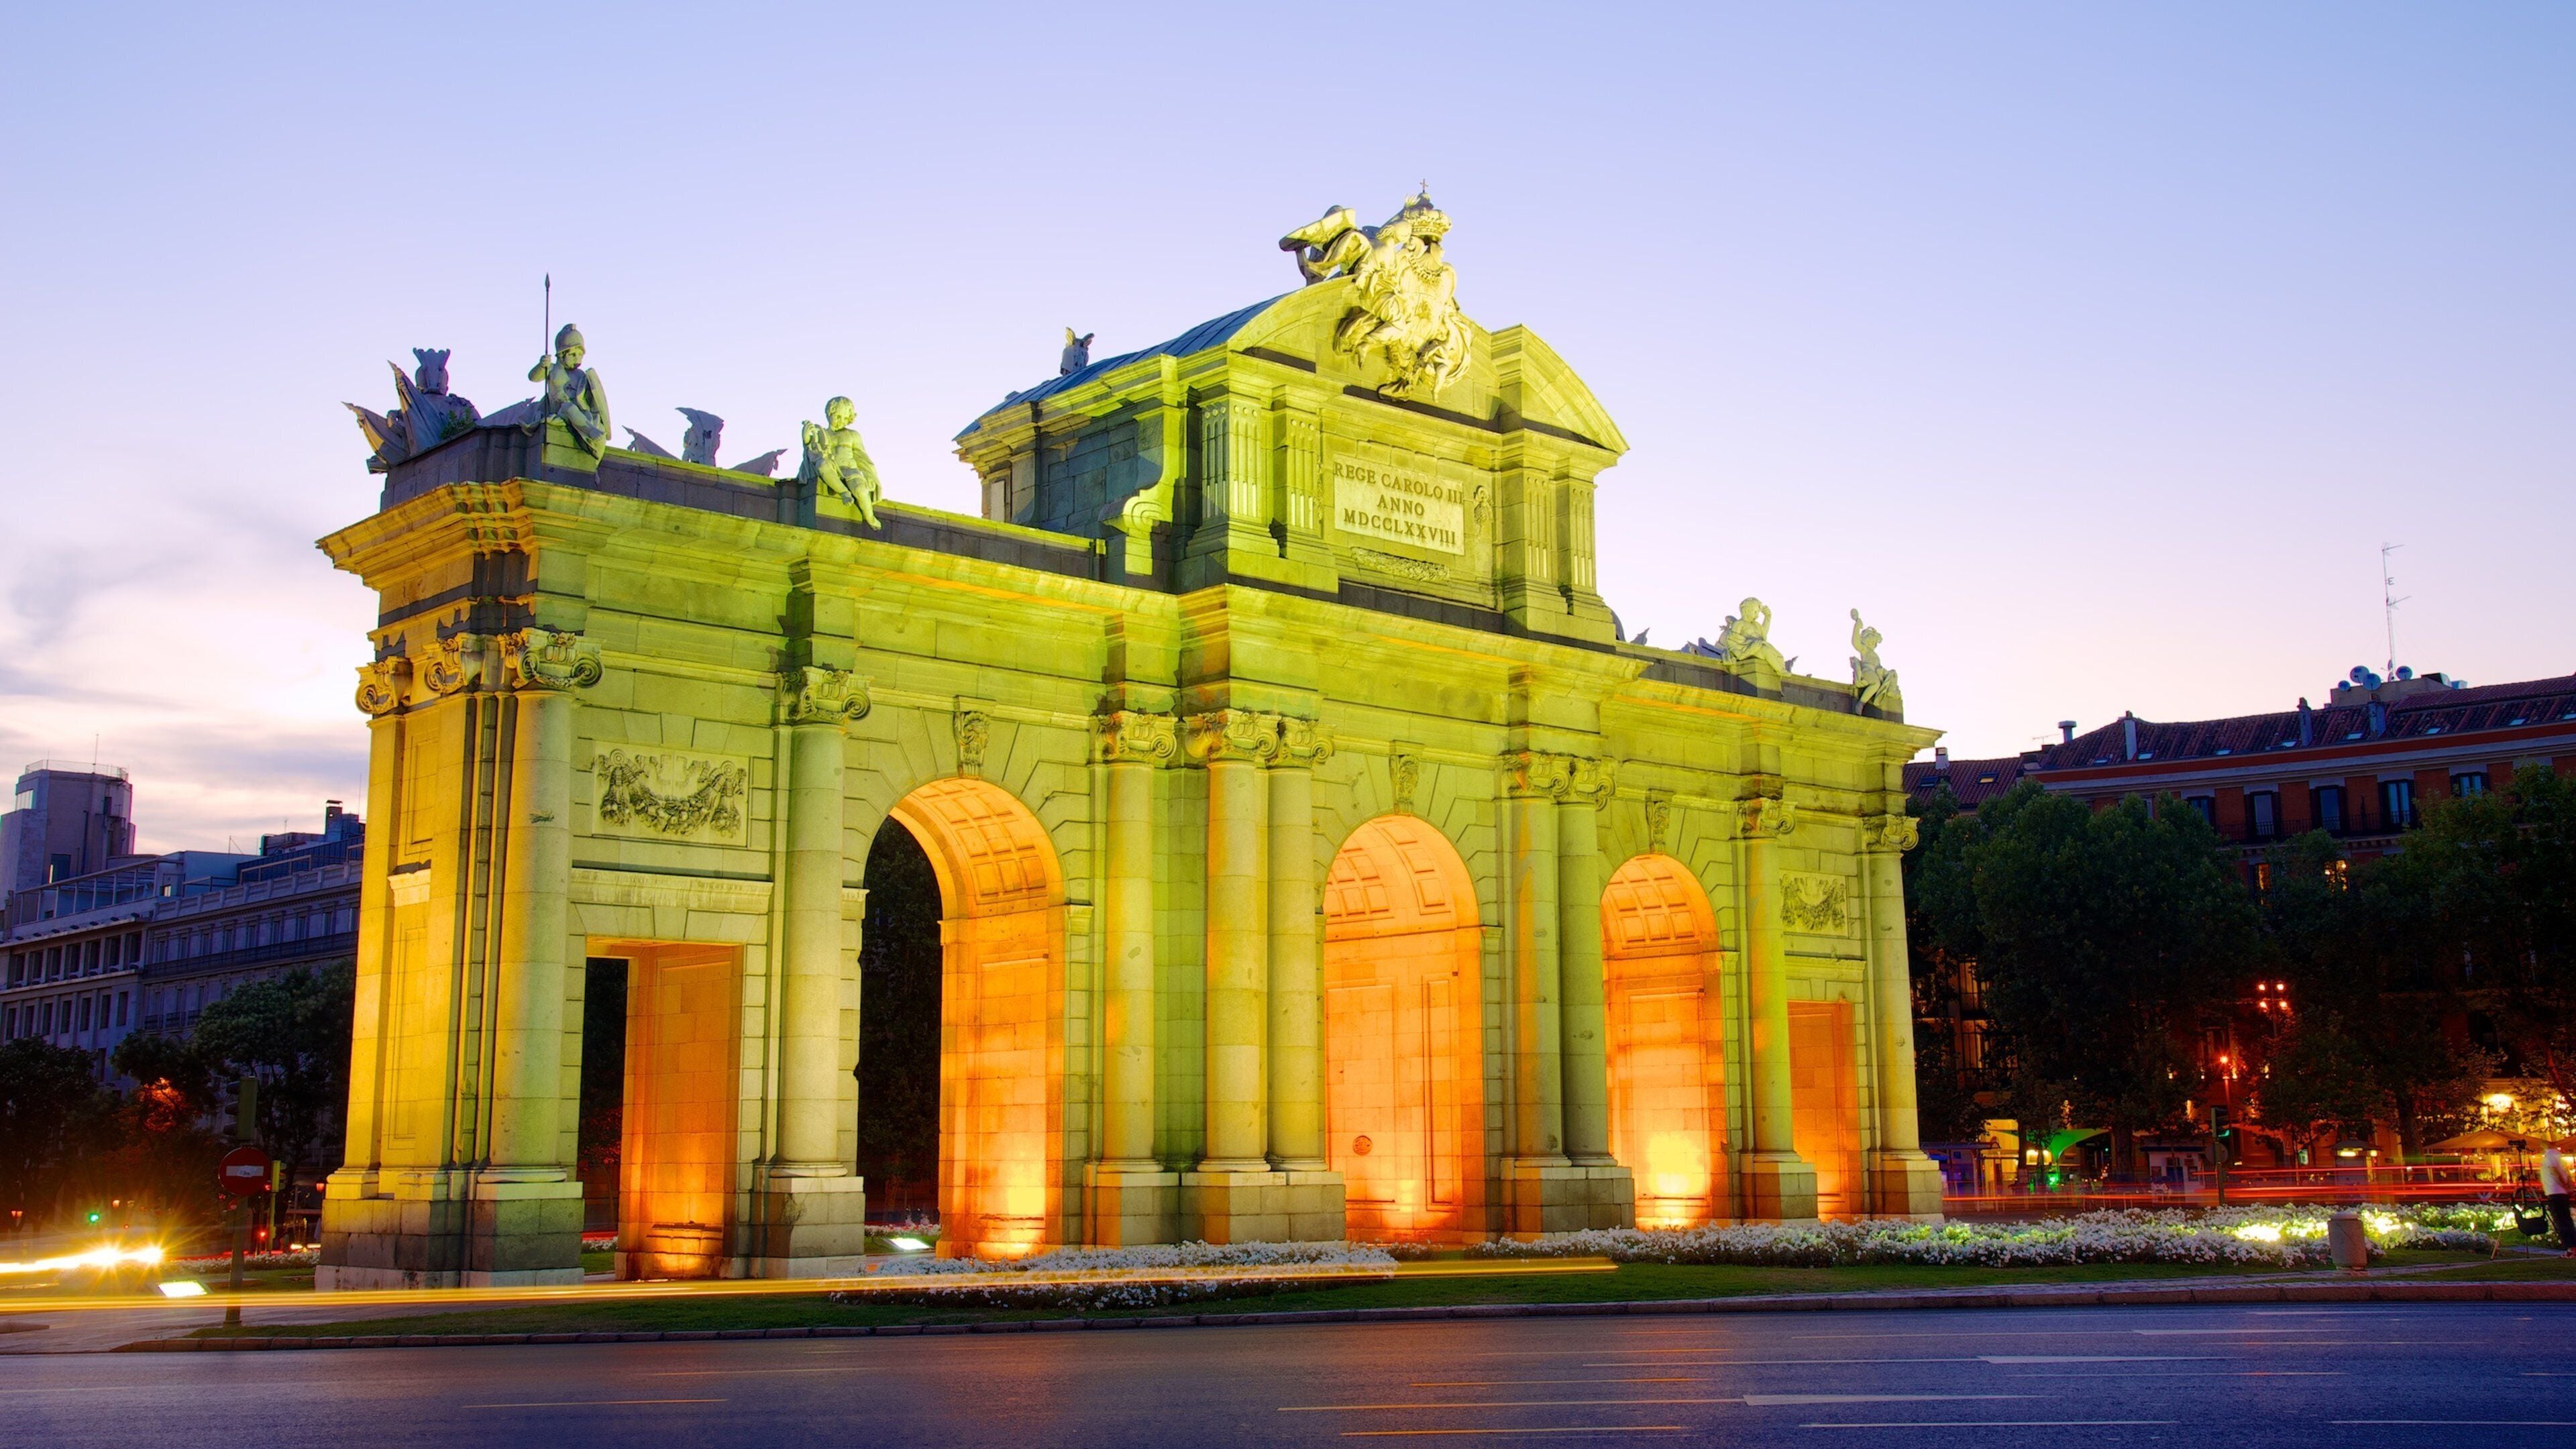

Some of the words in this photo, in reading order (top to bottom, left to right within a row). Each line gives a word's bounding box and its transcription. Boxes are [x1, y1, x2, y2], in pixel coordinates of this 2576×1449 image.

[1334, 462, 1376, 484] REGE
[1381, 474, 1443, 499] CAROLO
[1448, 489, 1464, 504] III
[1377, 494, 1425, 516] ANNO
[1344, 508, 1456, 544] MDCCLXXVIII
